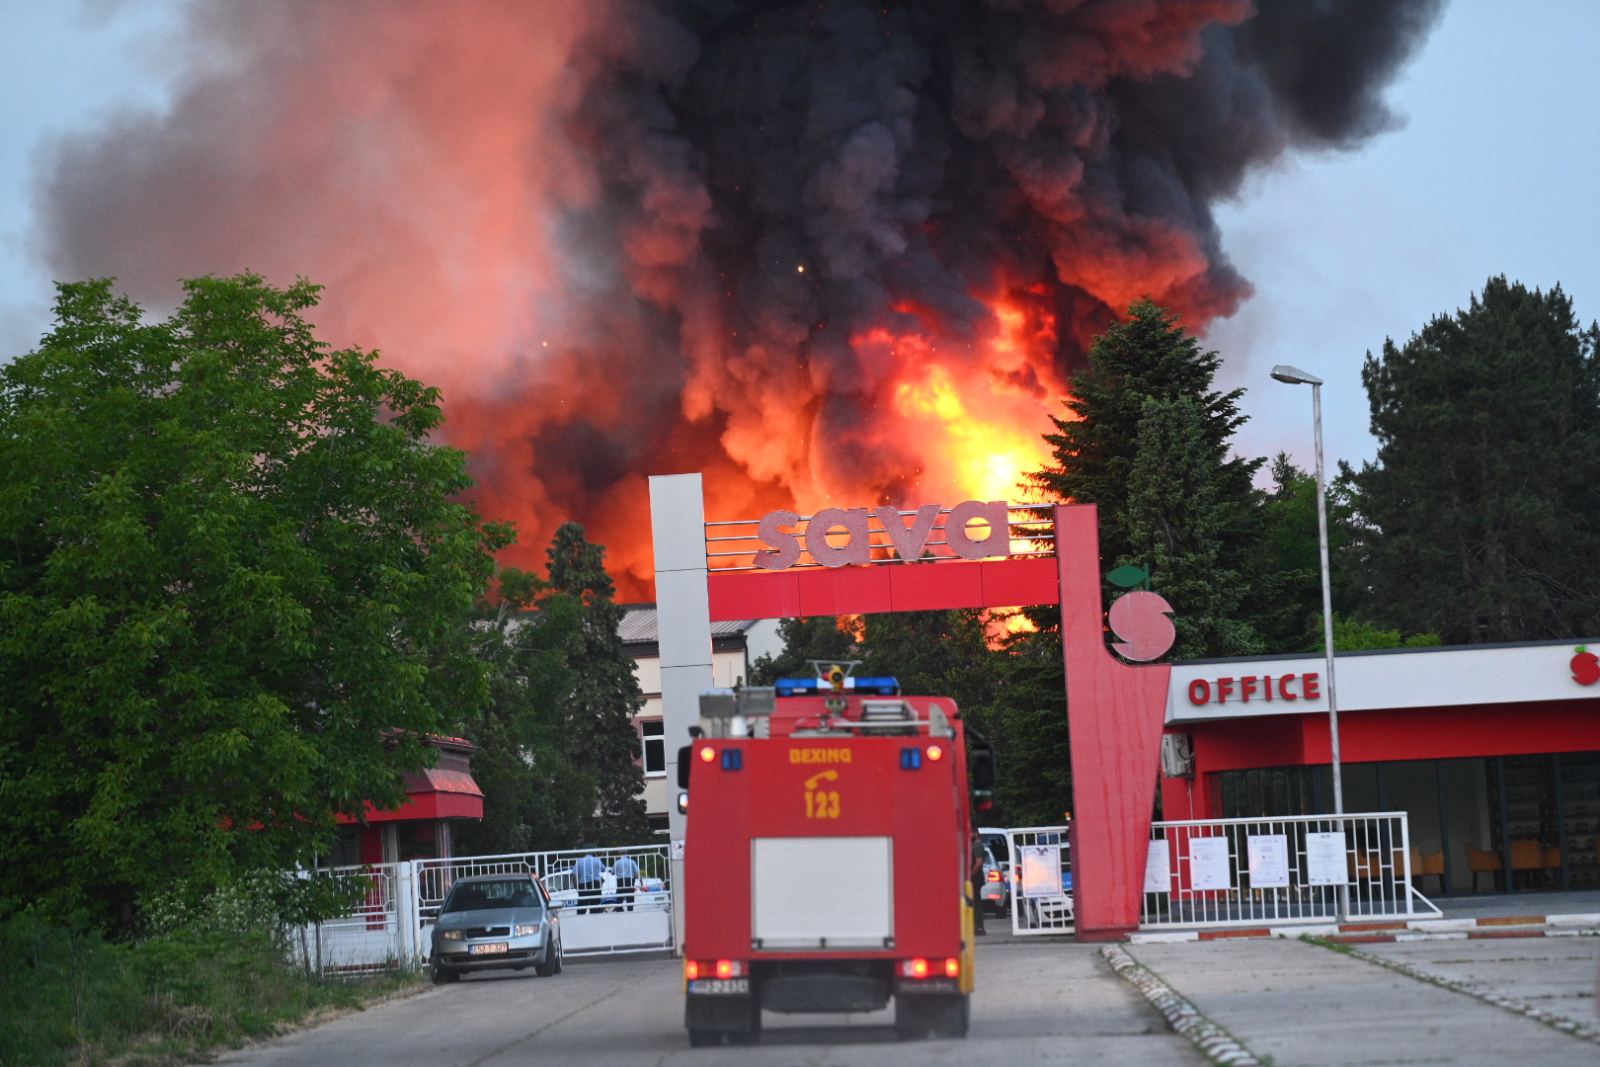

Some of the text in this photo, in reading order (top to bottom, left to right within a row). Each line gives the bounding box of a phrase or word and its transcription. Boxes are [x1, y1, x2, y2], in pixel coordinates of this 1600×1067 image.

[752, 500, 1010, 570] sava
[1188, 672, 1321, 706] OFFICE
[789, 748, 852, 765] BEXING
[804, 791, 841, 818] 123
